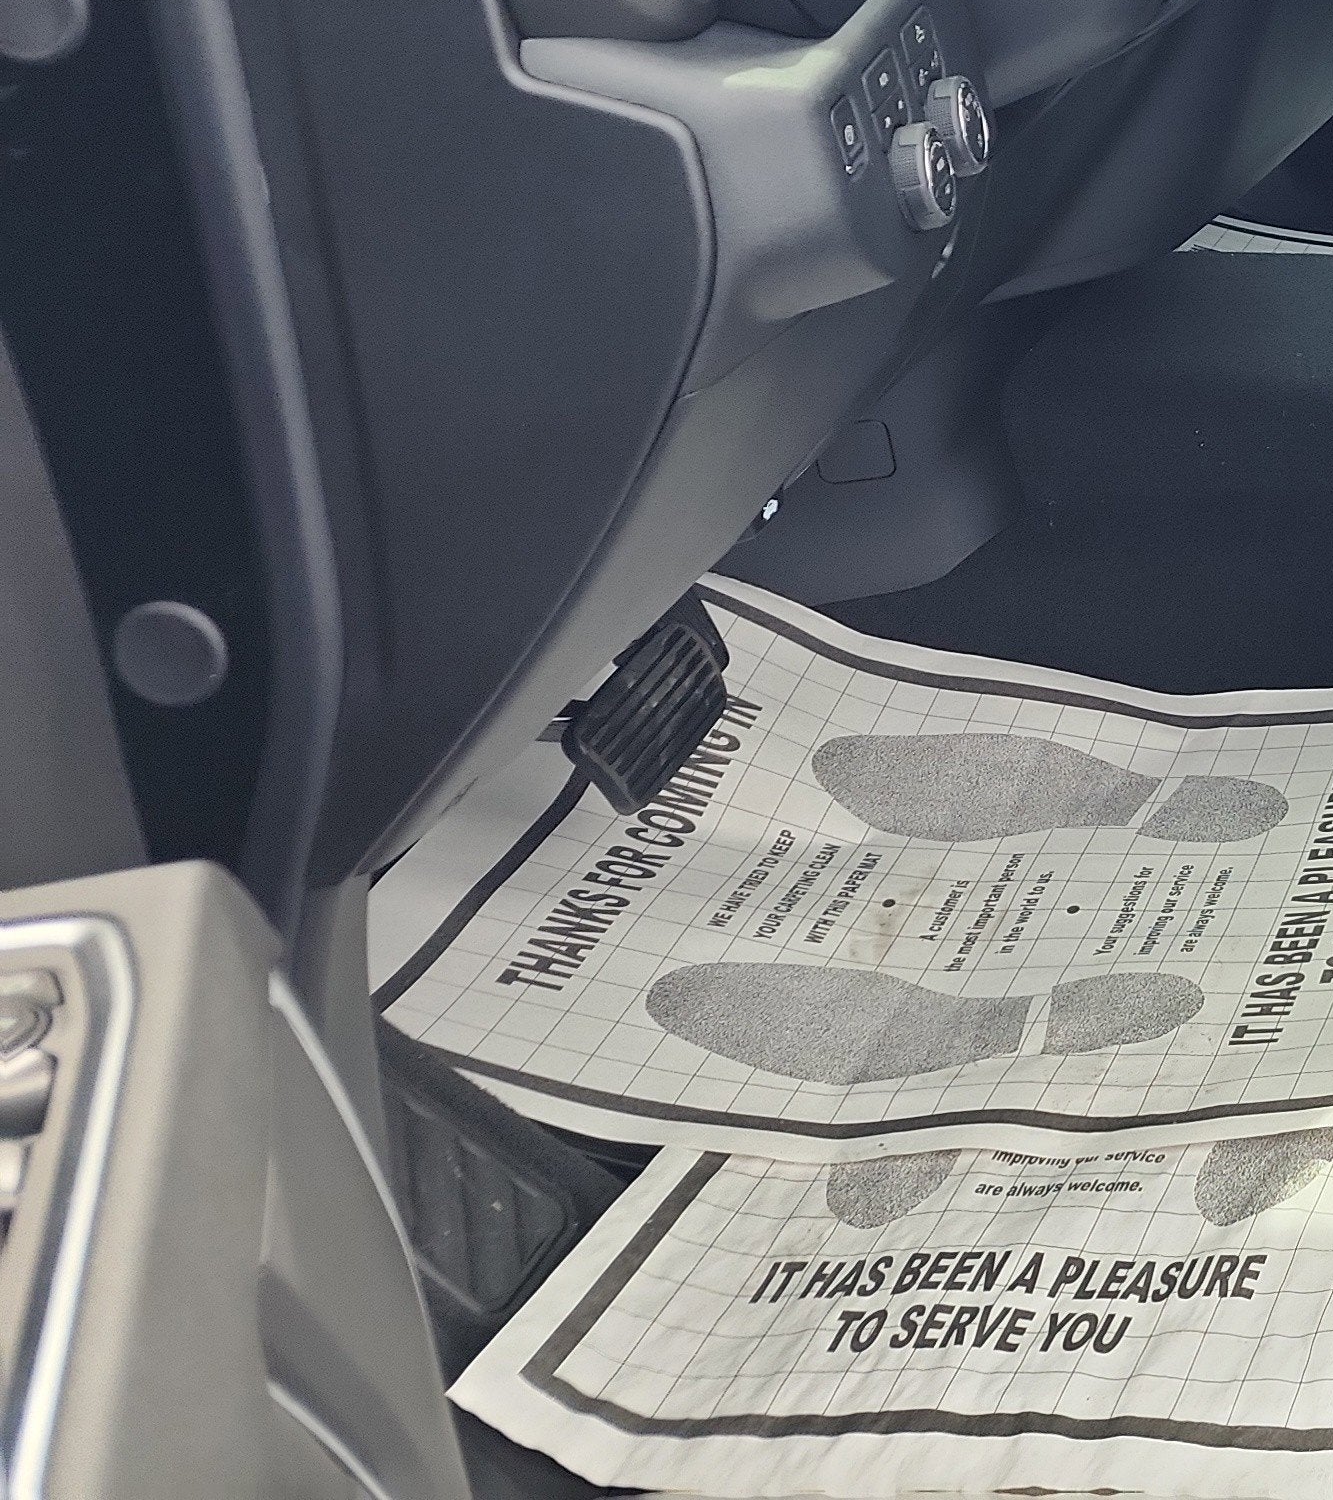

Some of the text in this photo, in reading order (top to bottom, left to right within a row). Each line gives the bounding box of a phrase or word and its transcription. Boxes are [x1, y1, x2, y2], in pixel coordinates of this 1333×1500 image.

[495, 693, 763, 991] THANKS FOR COMING IN
[707, 829, 796, 928] WE HAVE TRIED TO KEEP
[753, 842, 842, 940] YOUR CARPETING CLEAN
[804, 852, 883, 944] WITH THIS PAPER MAT
[1027, 886, 1045, 895] to
[919, 879, 970, 942] A customer is
[943, 853, 1025, 972] the most important person
[1003, 926, 1024, 943] the
[1015, 897, 1040, 925] world
[1092, 867, 1154, 956] Your suggestions for
[1133, 864, 1194, 955] improving our service
[1180, 866, 1234, 953] are always welcome.
[994, 944, 1015, 954] in
[1263, 910, 1330, 964] BEEN
[1241, 972, 1305, 1017] HAS
[1228, 1025, 1283, 1045] IT
[974, 1179, 1143, 1197] are always welcome.
[749, 1250, 1268, 1304] IT HAS BEEN A PLEASURE
[827, 1304, 1133, 1354] TO SERVE YOU
